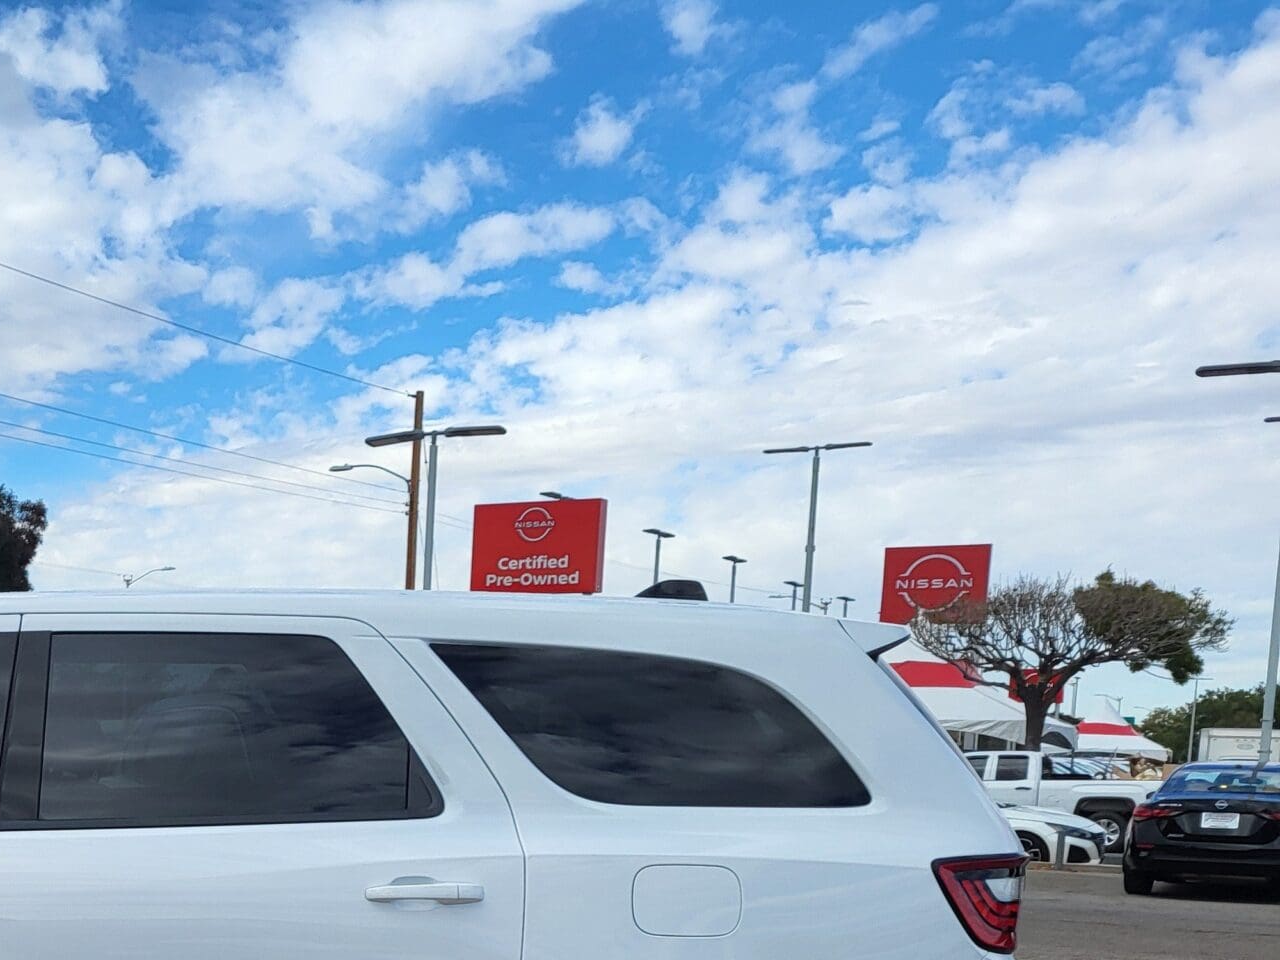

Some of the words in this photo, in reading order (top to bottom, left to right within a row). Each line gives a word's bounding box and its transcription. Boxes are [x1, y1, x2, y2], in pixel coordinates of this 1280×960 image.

[514, 520, 555, 529] NISSAN
[497, 554, 569, 570] Certified
[486, 571, 580, 586] Pre-Owned
[895, 578, 974, 589] NISSAN
